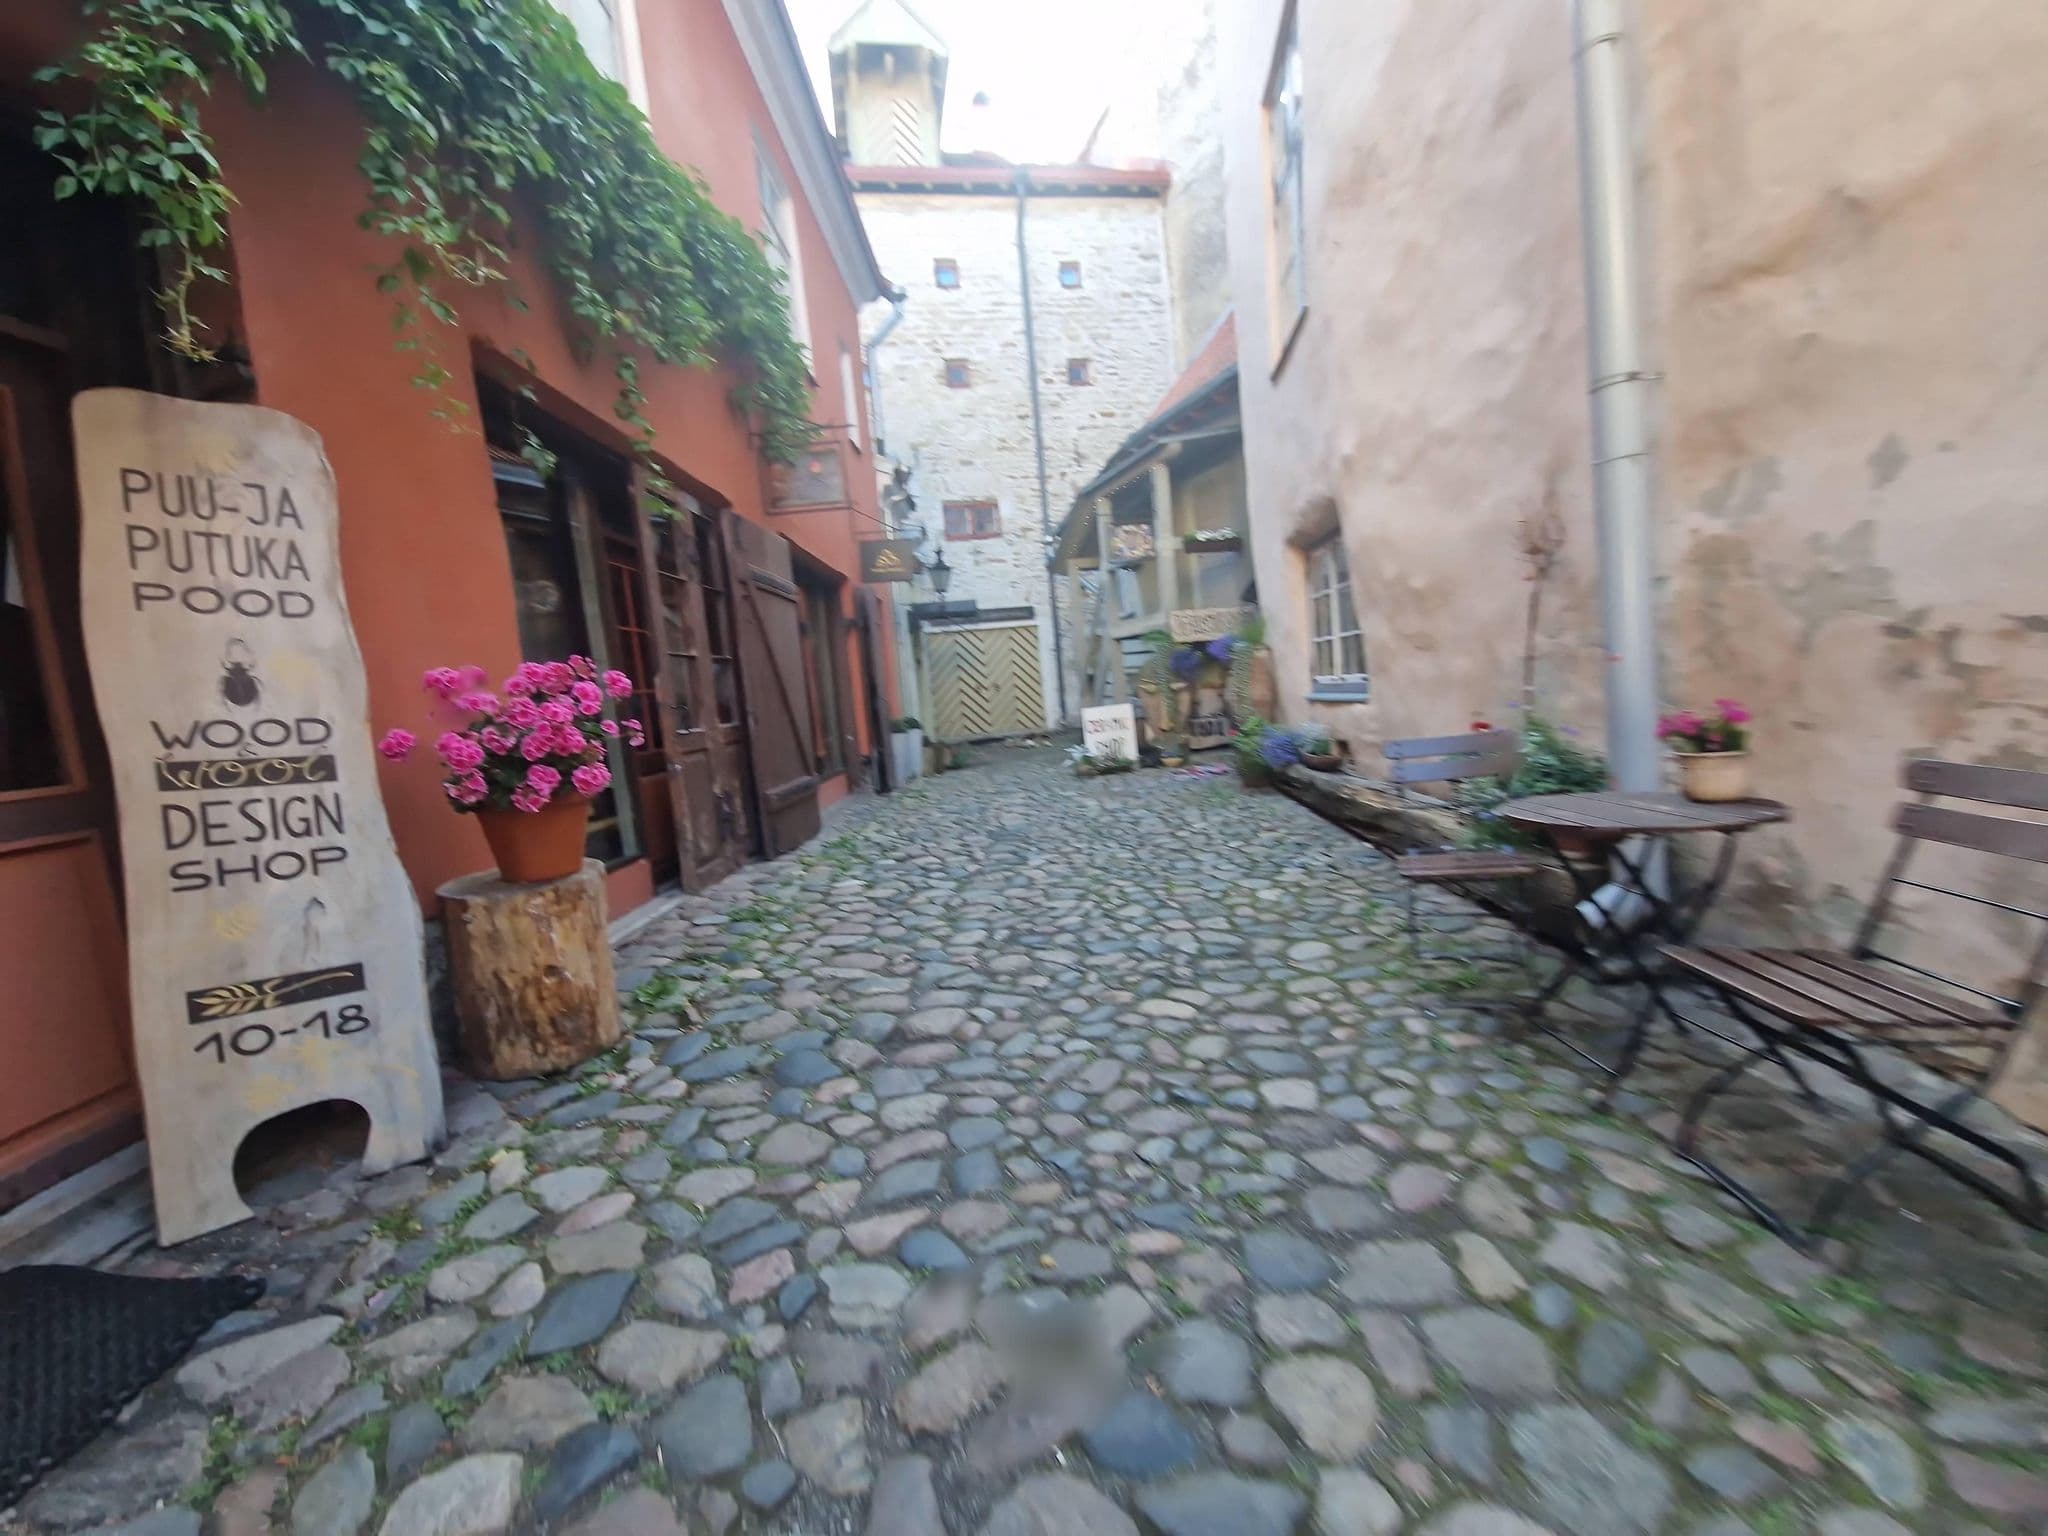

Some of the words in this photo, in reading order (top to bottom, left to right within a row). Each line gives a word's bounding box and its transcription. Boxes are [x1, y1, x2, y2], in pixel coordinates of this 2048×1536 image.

[125, 524, 310, 581] PUTUKA
[132, 582, 314, 618] POOD
[150, 717, 332, 749] WOOD
[160, 793, 345, 850] DESIGN
[169, 846, 349, 892] SHOP
[194, 1004, 370, 1063] 10-18
